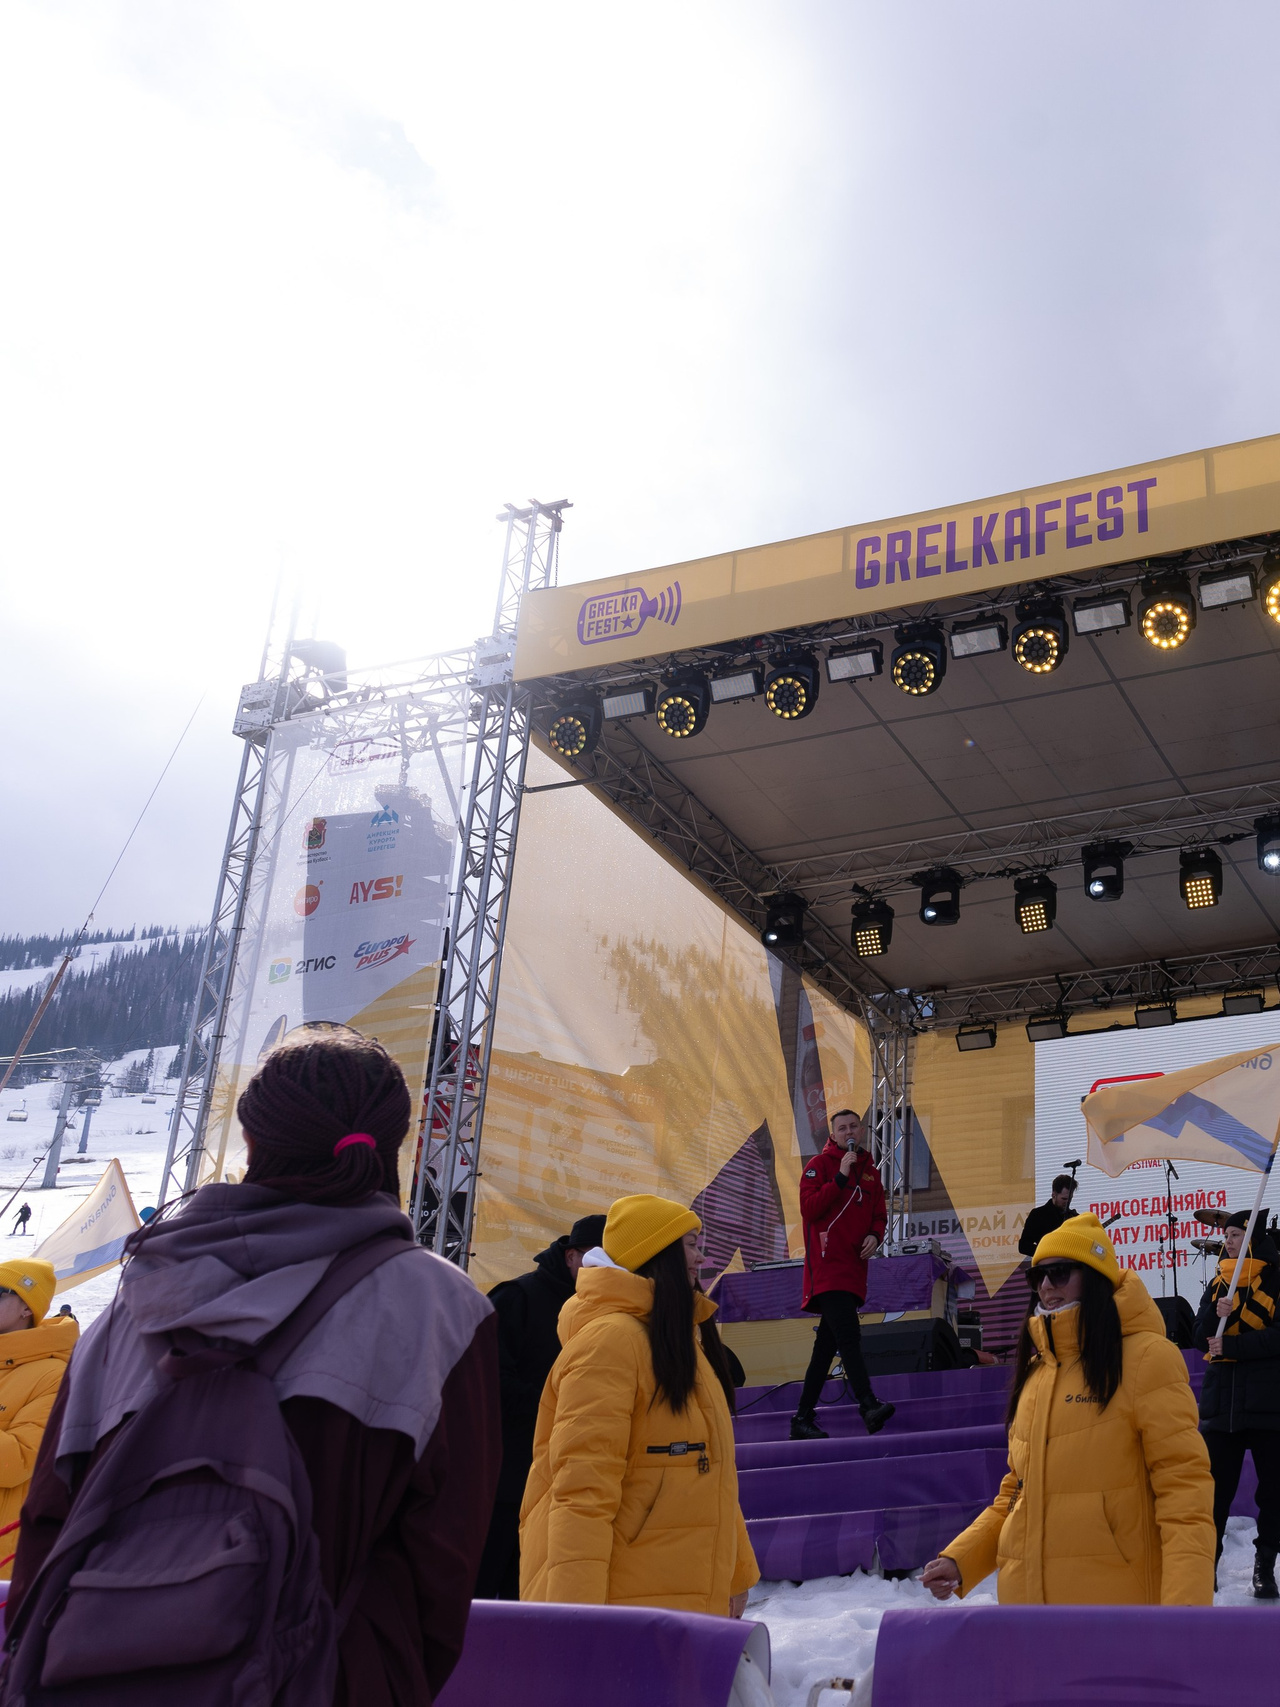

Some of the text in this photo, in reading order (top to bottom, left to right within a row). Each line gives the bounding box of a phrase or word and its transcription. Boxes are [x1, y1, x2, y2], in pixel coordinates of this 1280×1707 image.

[854, 477, 1158, 590] GRELKAFEST
[588, 594, 638, 620] GRELKA
[586, 616, 621, 638] FEST
[366, 828, 400, 840] ДИРЕКЦИЯ
[368, 836, 396, 846] КУРОРТА
[367, 843, 396, 853] ШЕРЕГЕШ
[349, 875, 404, 905] AYS!
[294, 955, 337, 975] 2ГИС
[1089, 1189, 1227, 1220] ПРИСОЕДИНЯЙСЯ
[905, 1210, 1006, 1237] ВЫБИРАЙ
